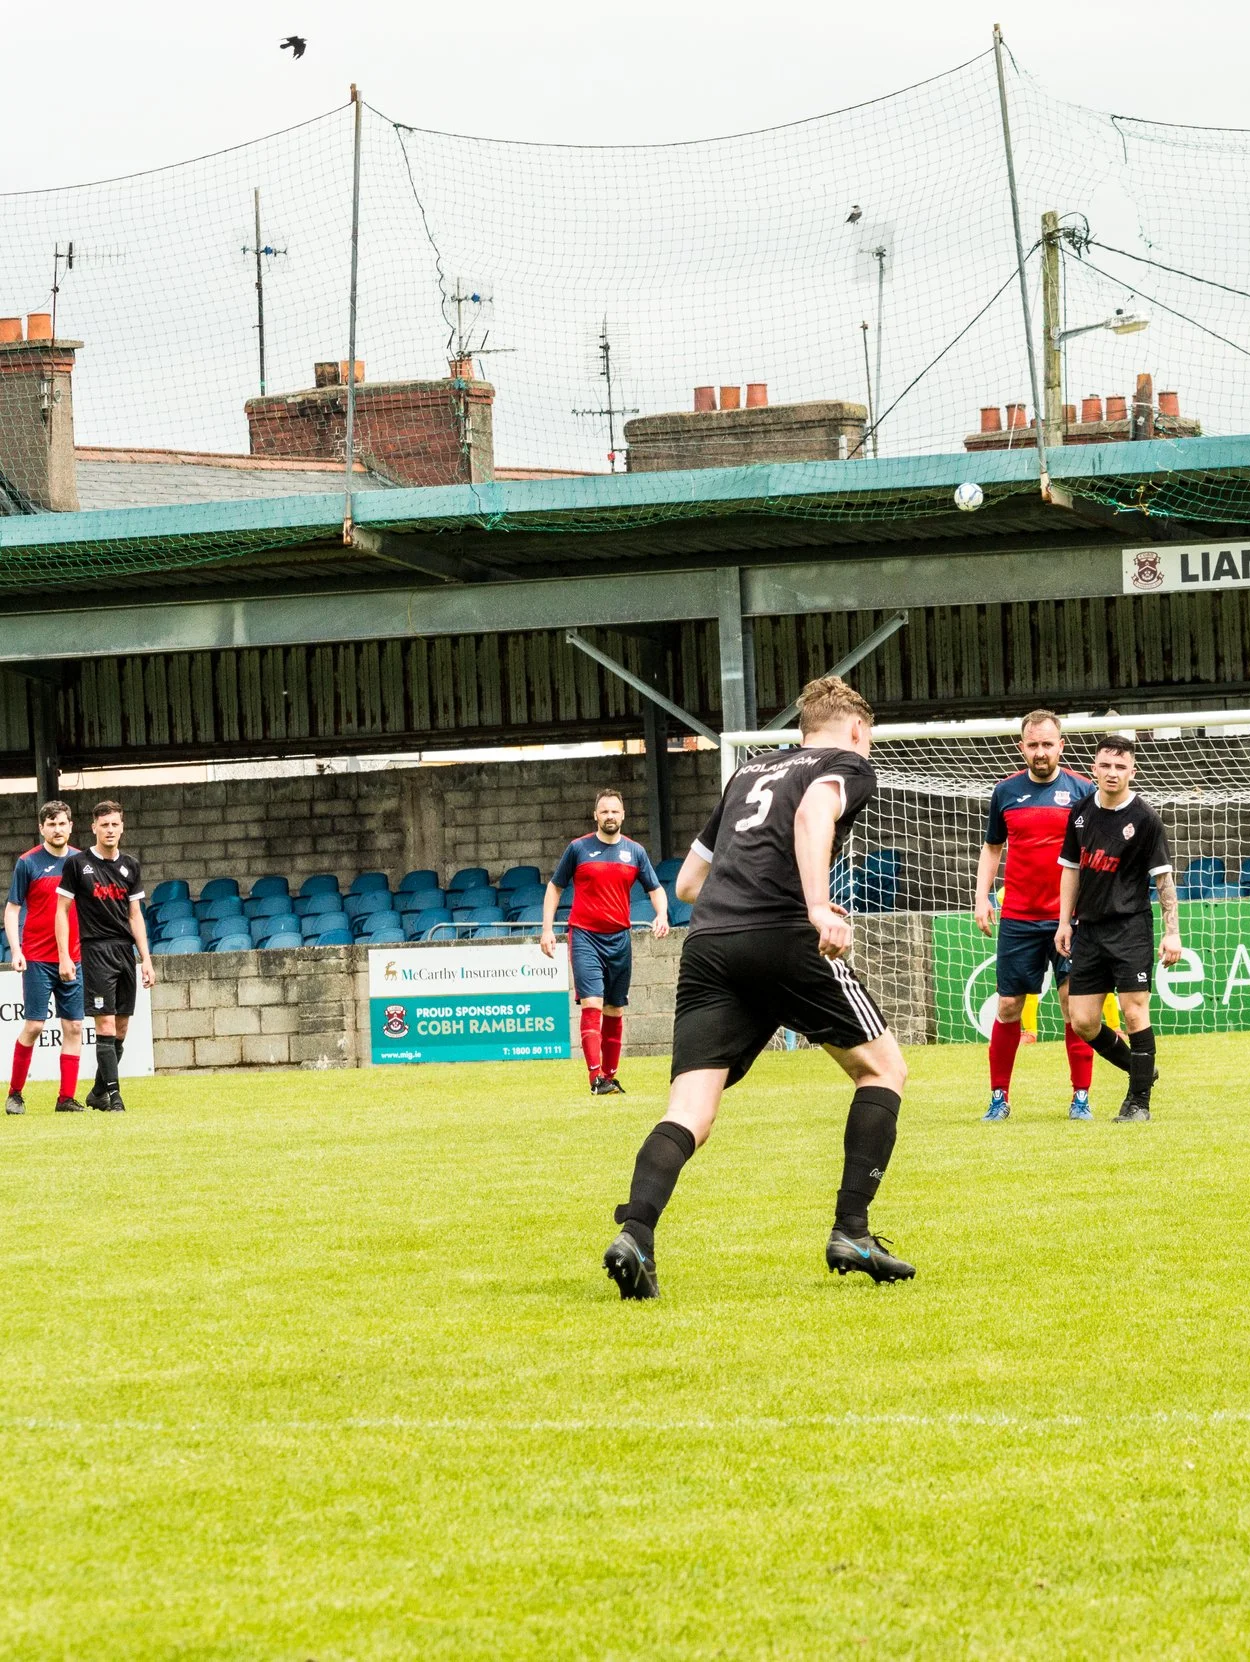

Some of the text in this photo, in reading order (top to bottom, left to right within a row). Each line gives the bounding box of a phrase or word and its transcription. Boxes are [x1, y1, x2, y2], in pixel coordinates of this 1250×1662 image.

[735, 767, 790, 832] 5
[402, 964, 558, 983] McCarthy Insurance Group
[416, 1007, 453, 1018] PROUD
[455, 1005, 514, 1017] SPONSORS
[516, 1004, 531, 1015] OF
[417, 1019, 464, 1036] COBH
[469, 1017, 556, 1034] RAMBLERS
[512, 1046, 530, 1056] 1800
[545, 1045, 553, 1054] 11
[554, 1045, 562, 1054] 11
